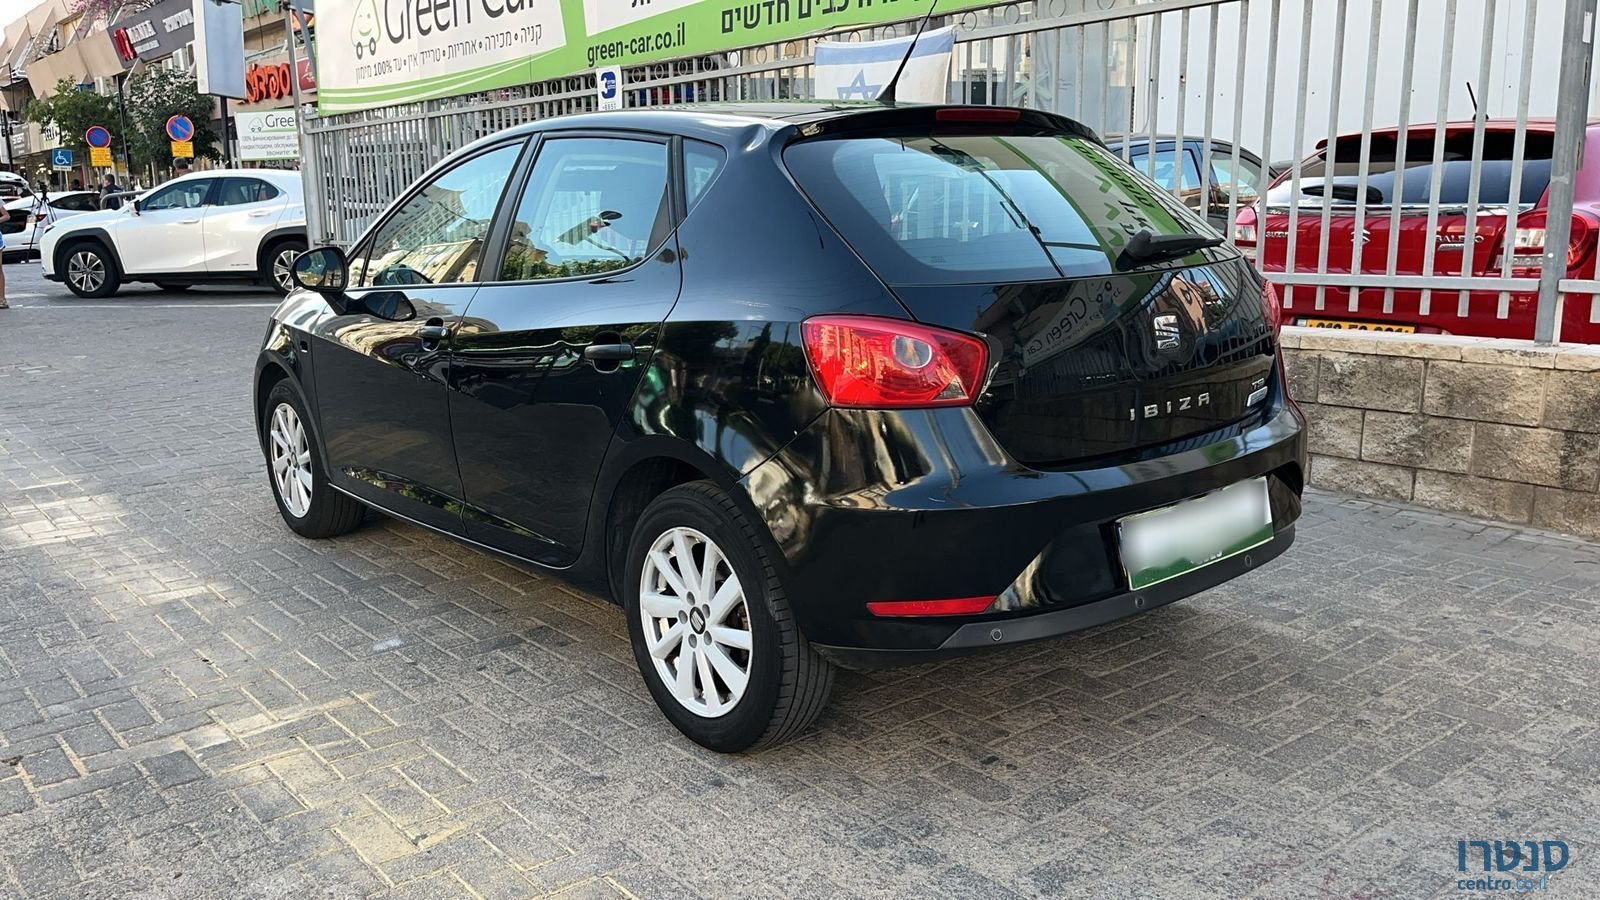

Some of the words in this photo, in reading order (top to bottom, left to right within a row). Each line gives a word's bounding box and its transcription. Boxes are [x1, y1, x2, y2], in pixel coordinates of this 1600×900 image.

[721, 0, 790, 34] חדשים
[485, 31, 512, 52] מכירה
[521, 24, 542, 45] קניה
[587, 22, 685, 68] green-car.co.il
[420, 47, 440, 65] טרייד
[448, 39, 477, 60] אחריות
[374, 60, 392, 77] 100%
[265, 114, 295, 128] Gree
[1435, 234, 1484, 243] BALEO
[1129, 392, 1210, 421] IBIZA
